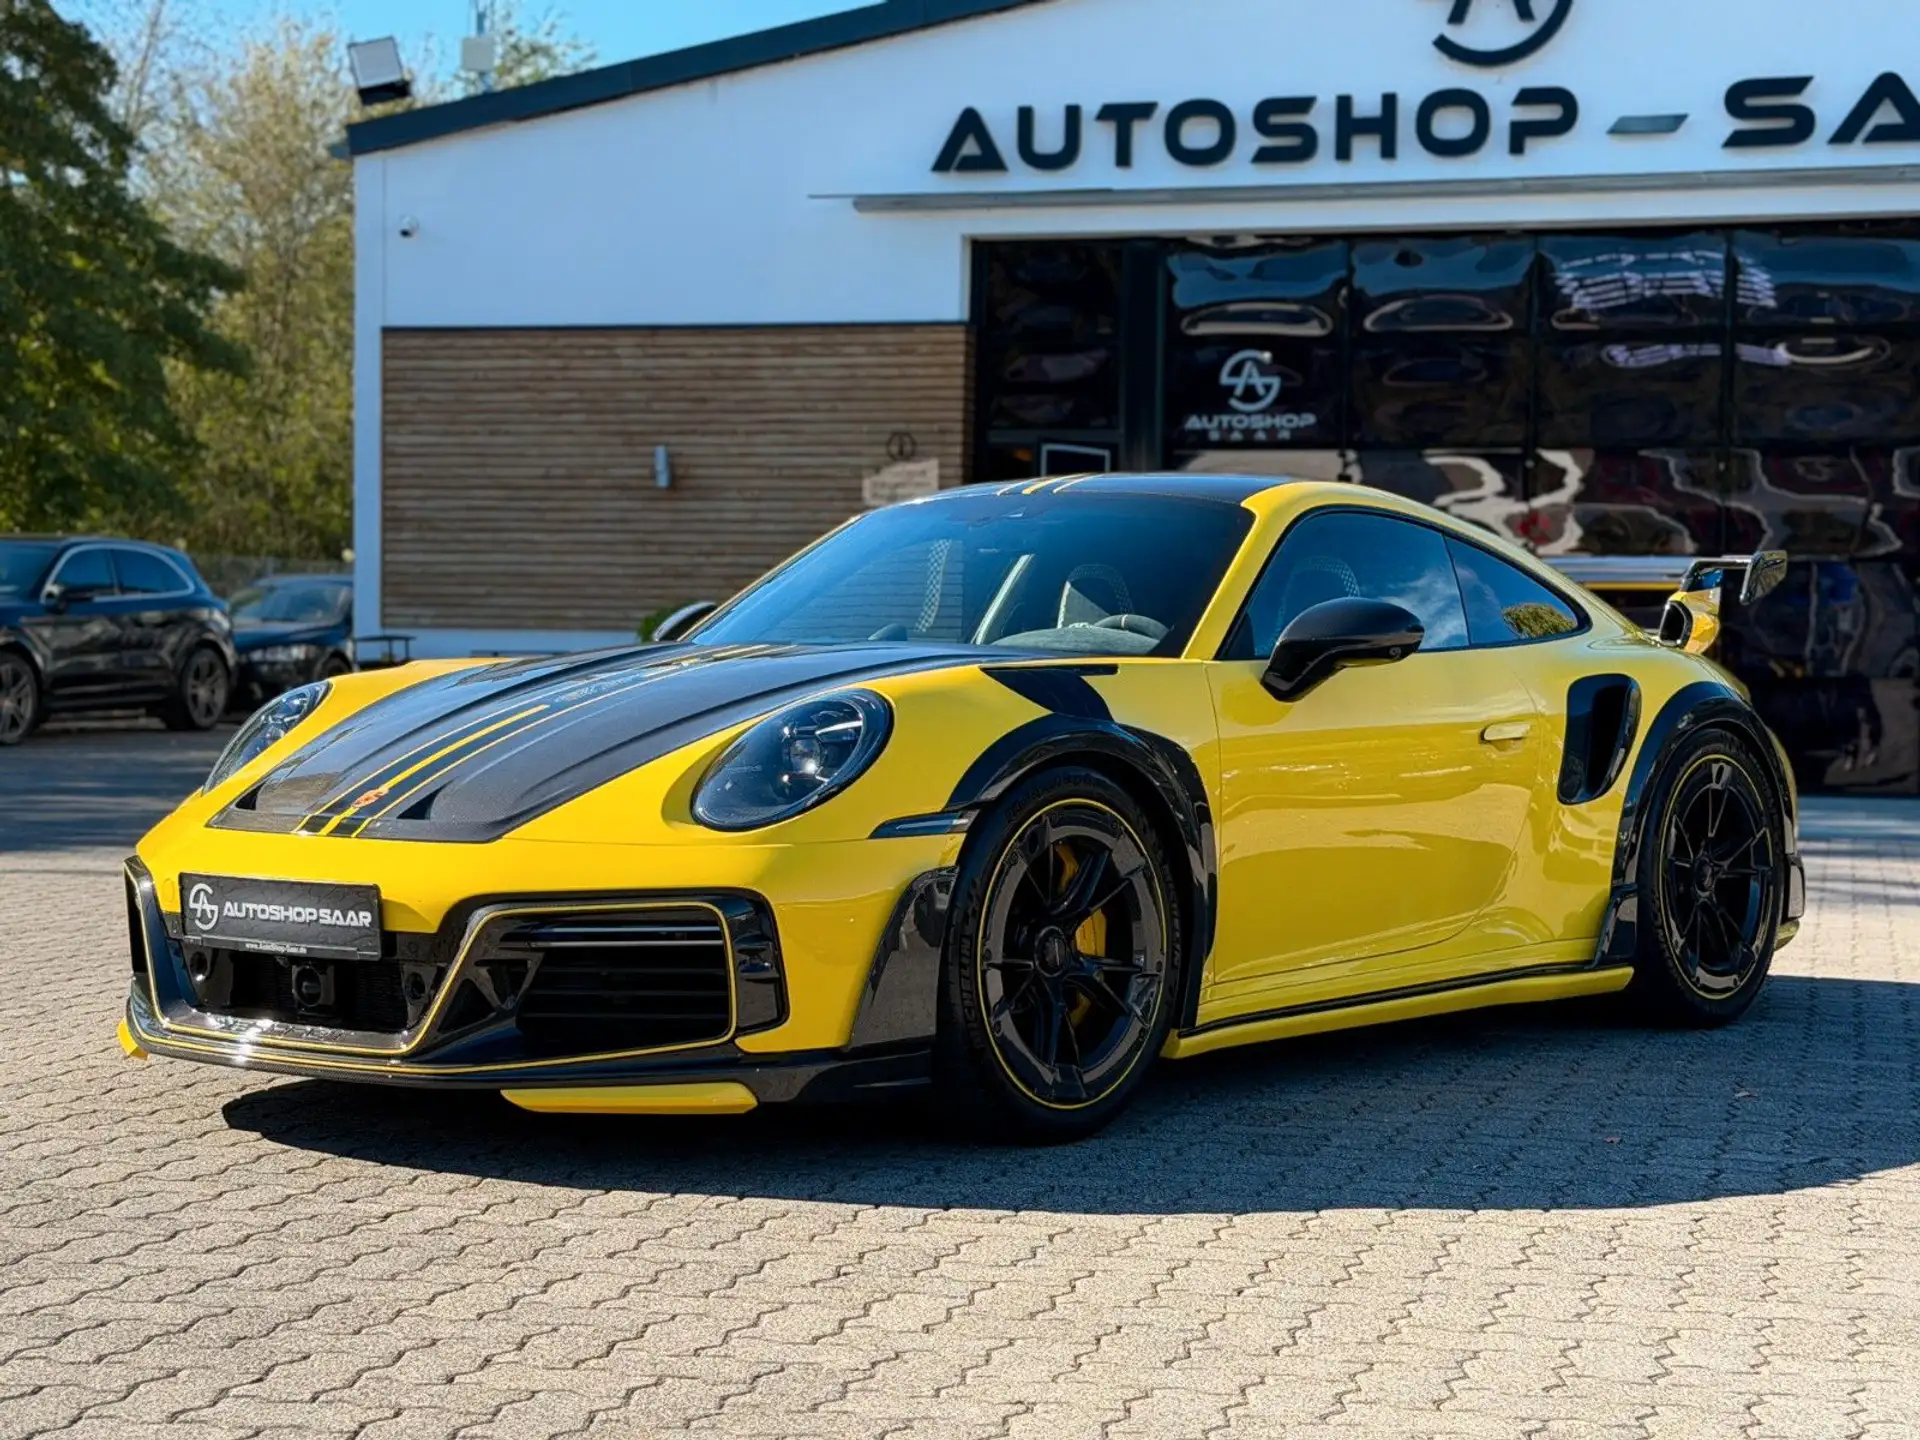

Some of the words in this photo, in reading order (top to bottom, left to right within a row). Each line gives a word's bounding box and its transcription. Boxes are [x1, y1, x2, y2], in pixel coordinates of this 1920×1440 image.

[931, 85, 1580, 173] AUTOSHOP
[1185, 413, 1317, 430] AUTOSHOP
[1208, 430, 1291, 441] SAAR
